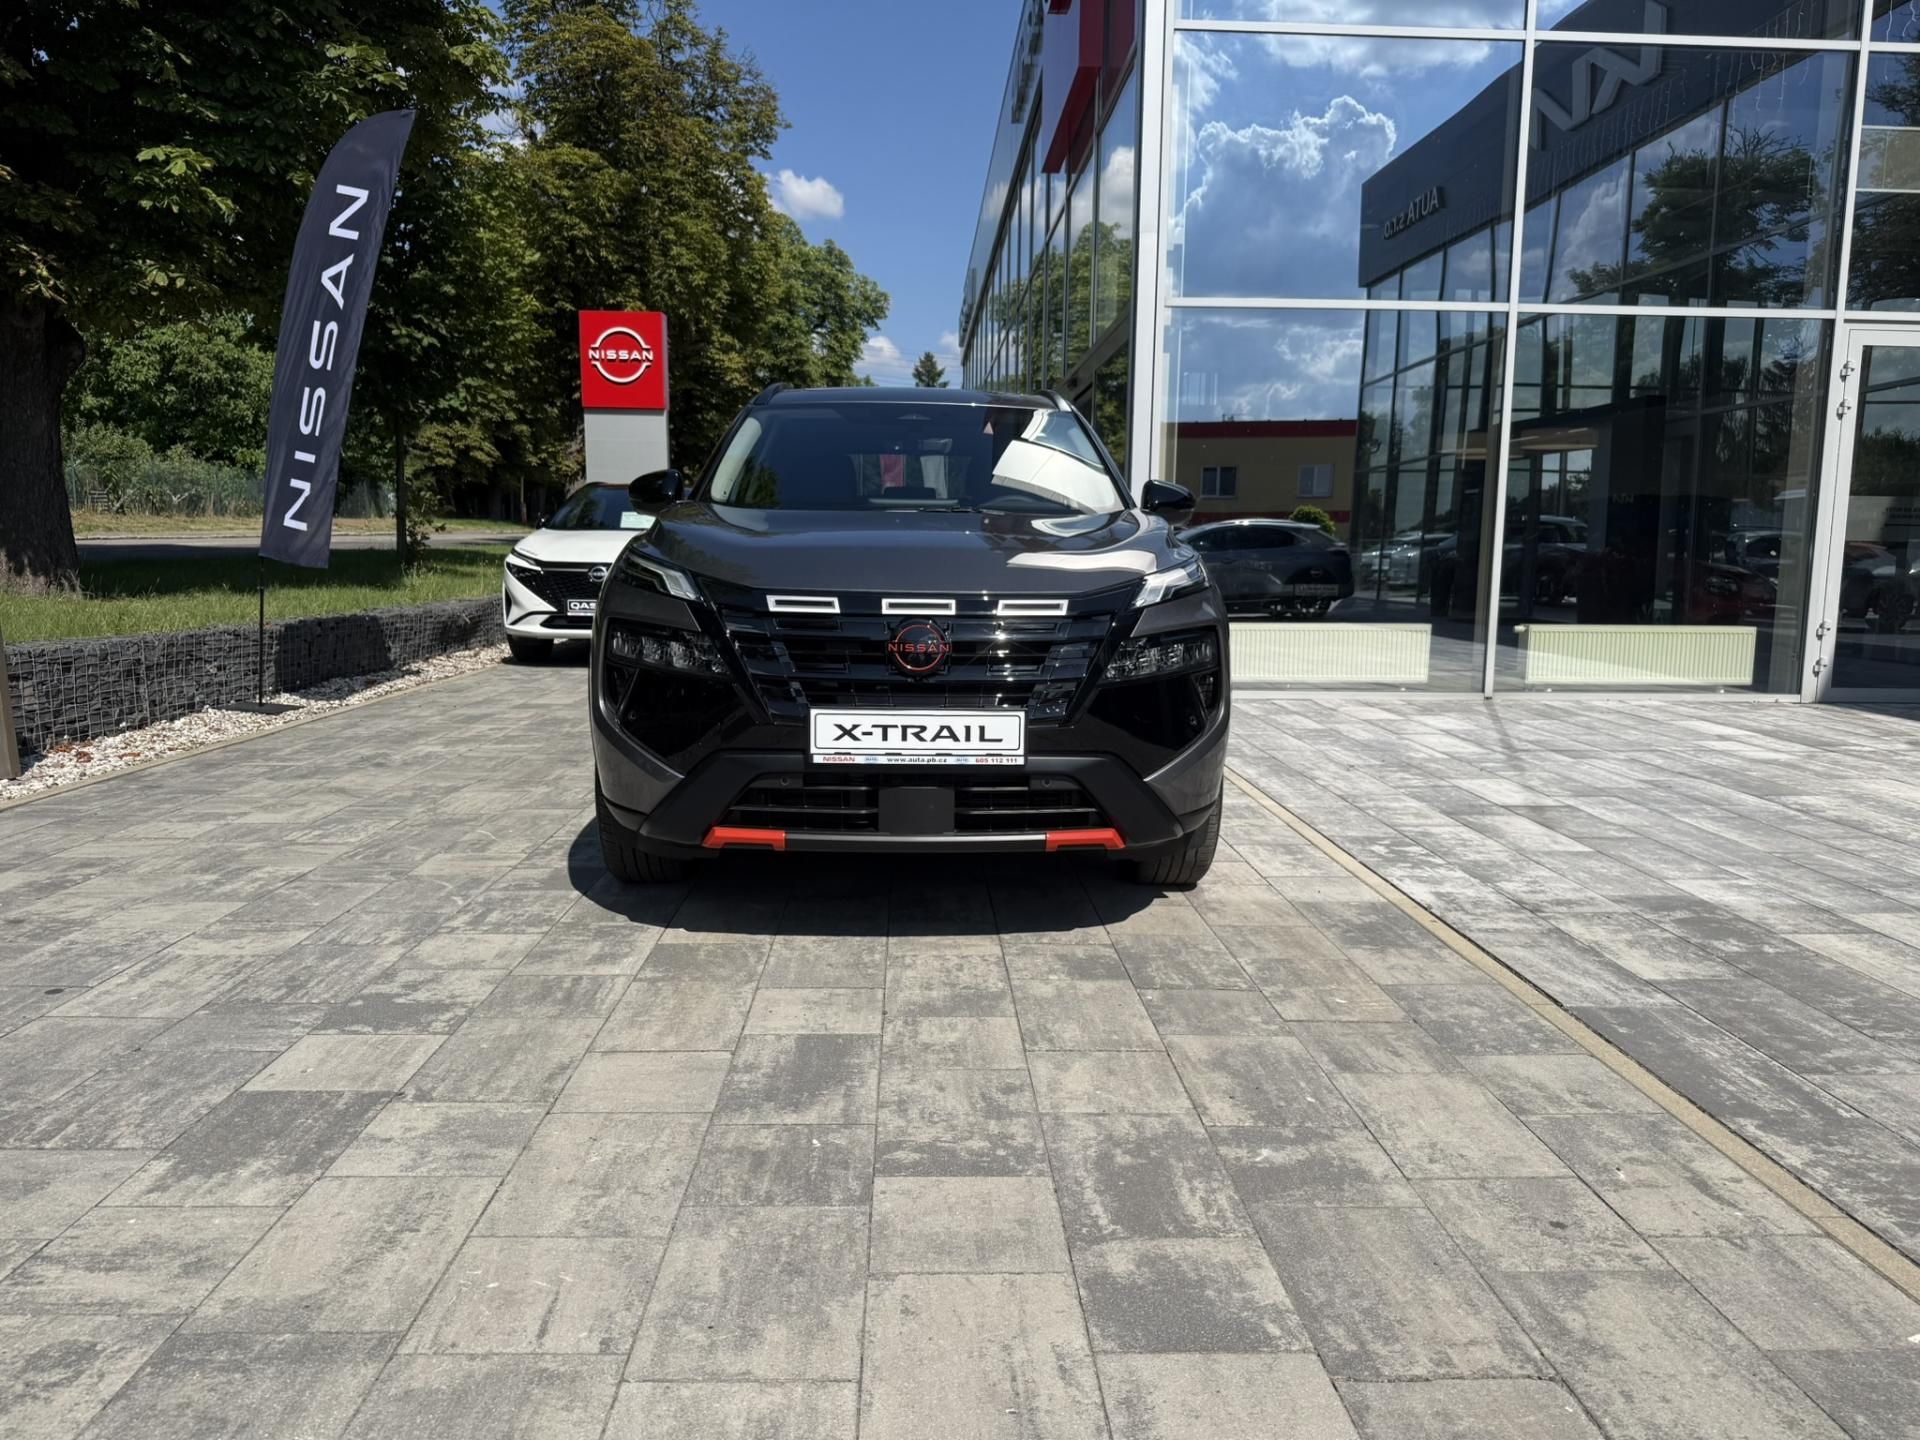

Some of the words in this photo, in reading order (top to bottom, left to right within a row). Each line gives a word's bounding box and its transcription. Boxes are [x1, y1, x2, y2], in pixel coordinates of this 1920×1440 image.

[283, 184, 369, 531] NISSAN
[588, 349, 653, 360] NISSAN
[888, 643, 949, 652] NISSAN
[832, 724, 1003, 742] X-TRAIL
